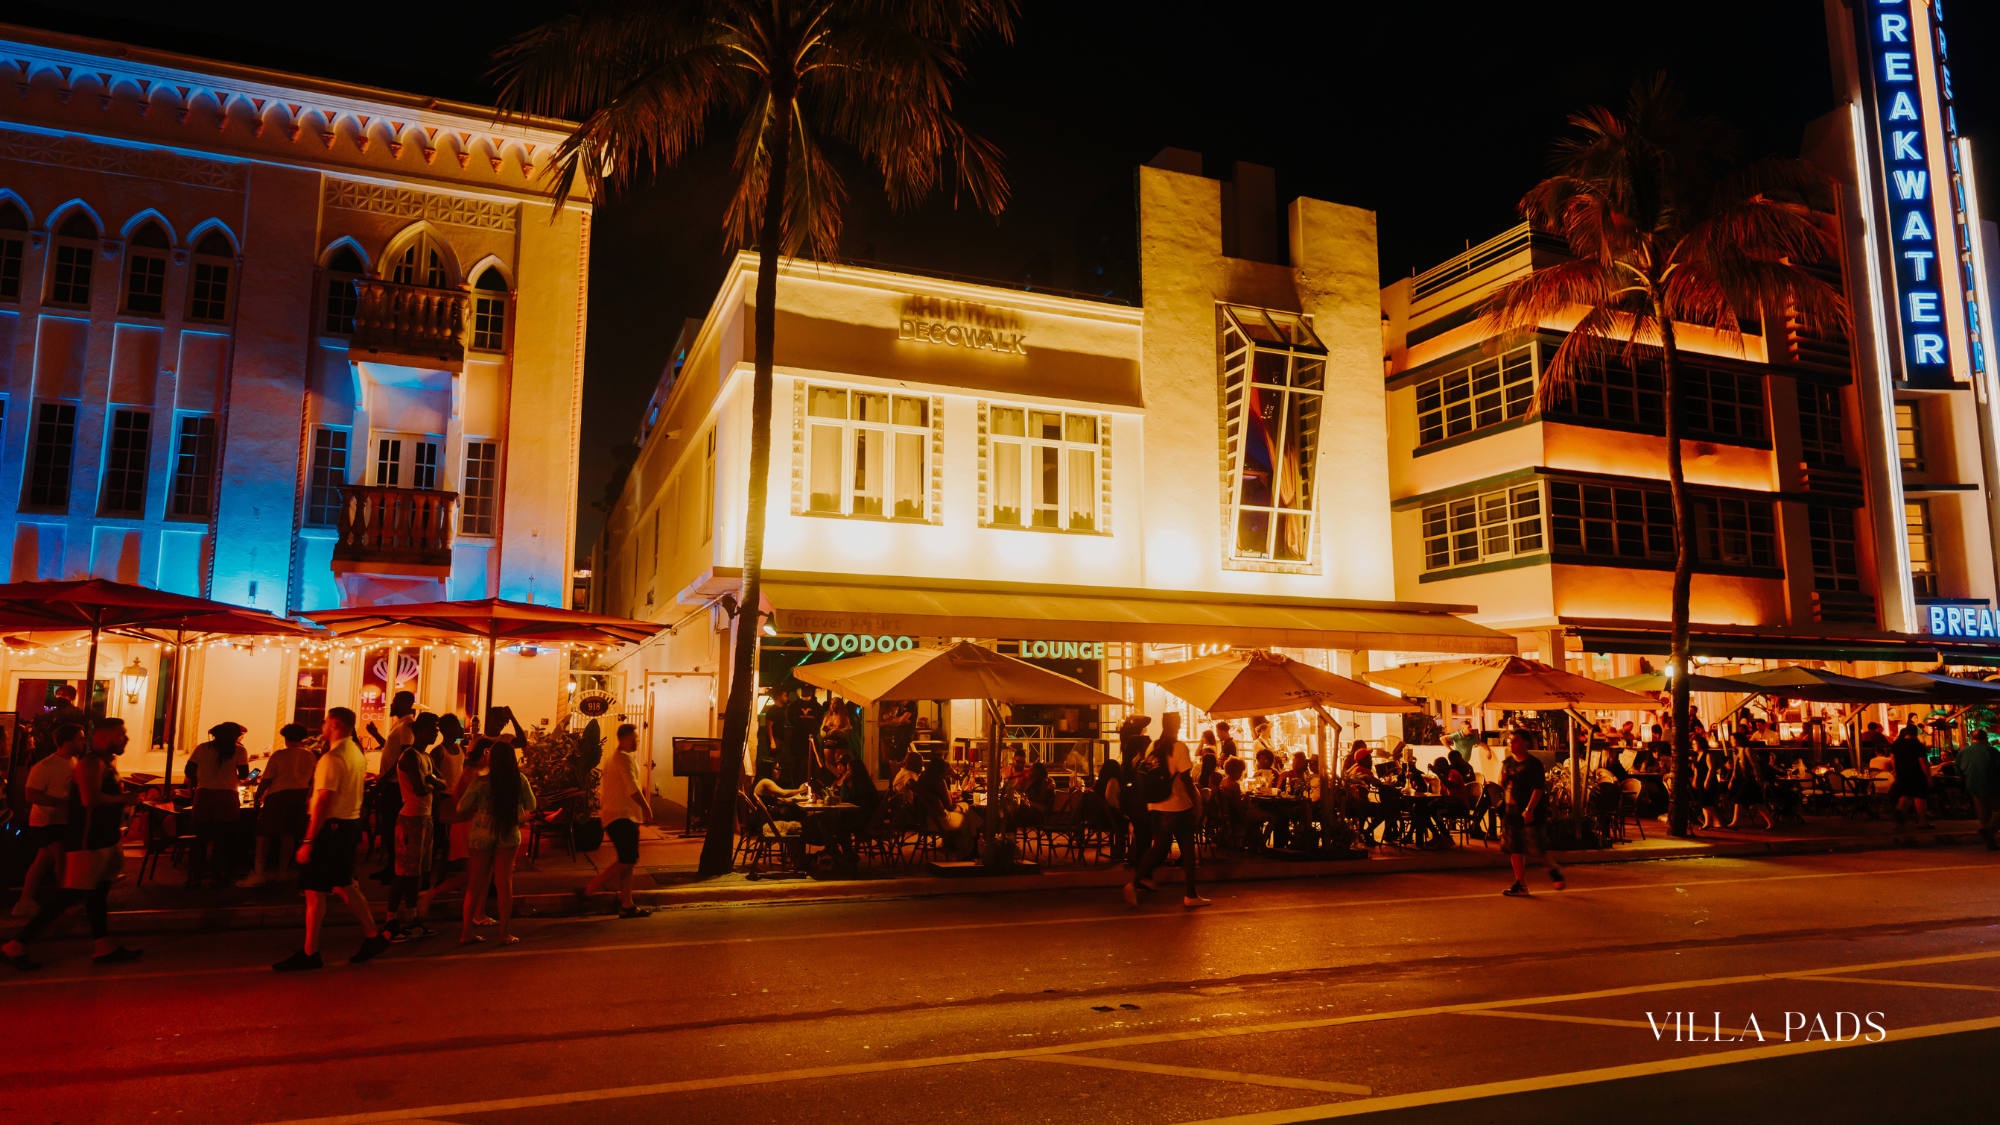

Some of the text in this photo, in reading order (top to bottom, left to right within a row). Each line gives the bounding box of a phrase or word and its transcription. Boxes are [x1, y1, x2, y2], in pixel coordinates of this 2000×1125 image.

[1878, 0, 1945, 364] REAKWATER
[899, 319, 1027, 354] DECOWALK
[787, 613, 844, 629] forever
[804, 633, 1105, 659] VOODOO LOUNGE
[43, 651, 88, 665] THE LOCUS
[361, 692, 377, 703] HE
[587, 702, 601, 711] 918
